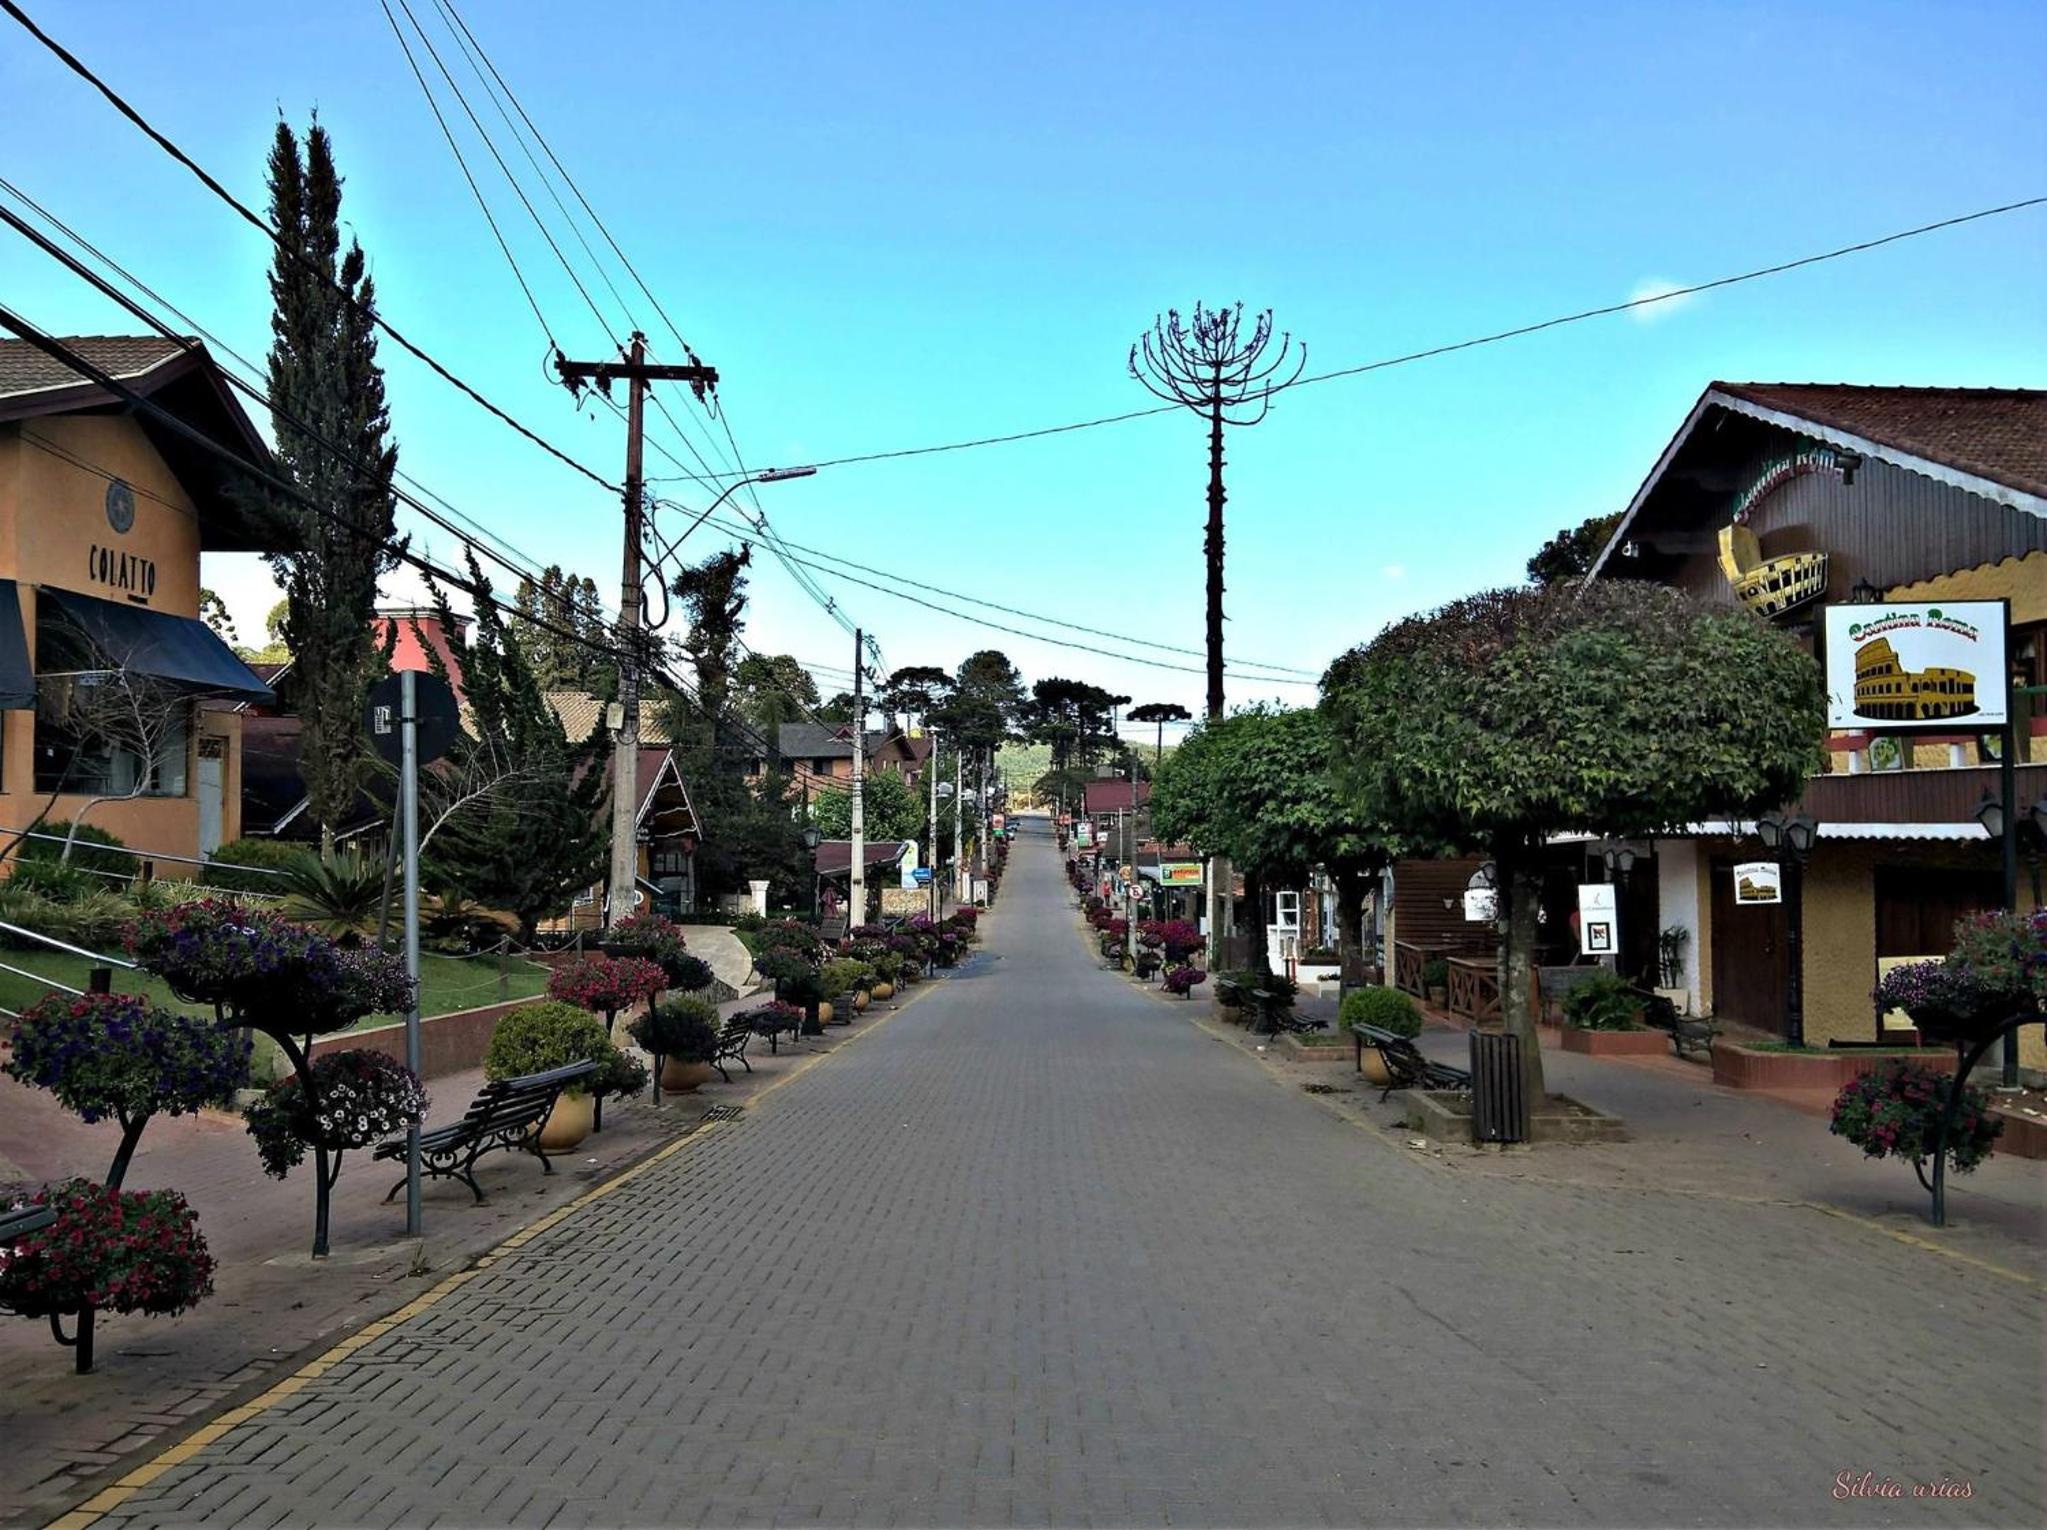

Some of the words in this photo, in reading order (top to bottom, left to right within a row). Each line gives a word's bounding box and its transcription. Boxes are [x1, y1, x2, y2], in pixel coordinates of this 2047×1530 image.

[89, 544, 155, 596] COLATTO
[1849, 612, 1921, 642] Cantina
[1926, 608, 1980, 642] Roma
